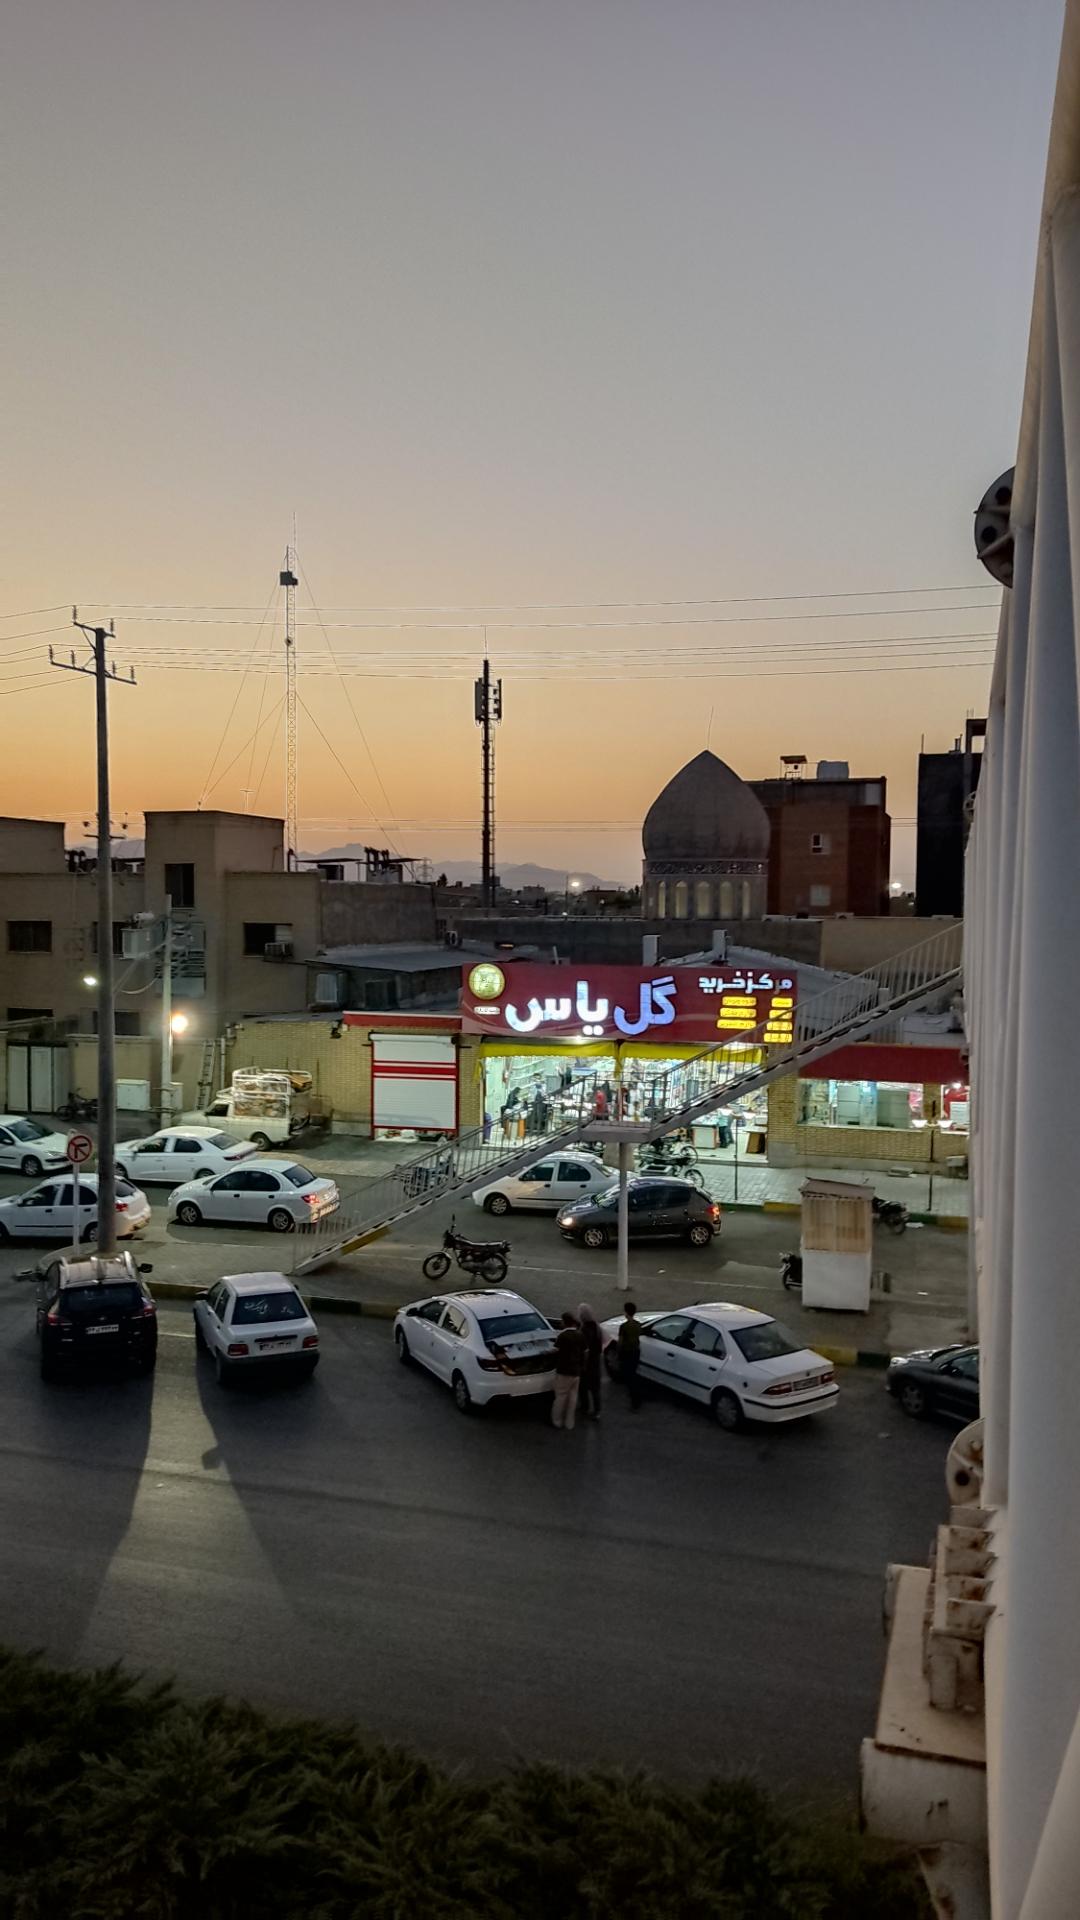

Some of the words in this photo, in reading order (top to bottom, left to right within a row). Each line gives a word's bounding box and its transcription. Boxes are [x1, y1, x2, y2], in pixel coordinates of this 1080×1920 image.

[698, 970, 746, 994] خرید
[745, 971, 793, 994] مرکز
[504, 980, 609, 1036] یاس
[613, 975, 678, 1035] گل
